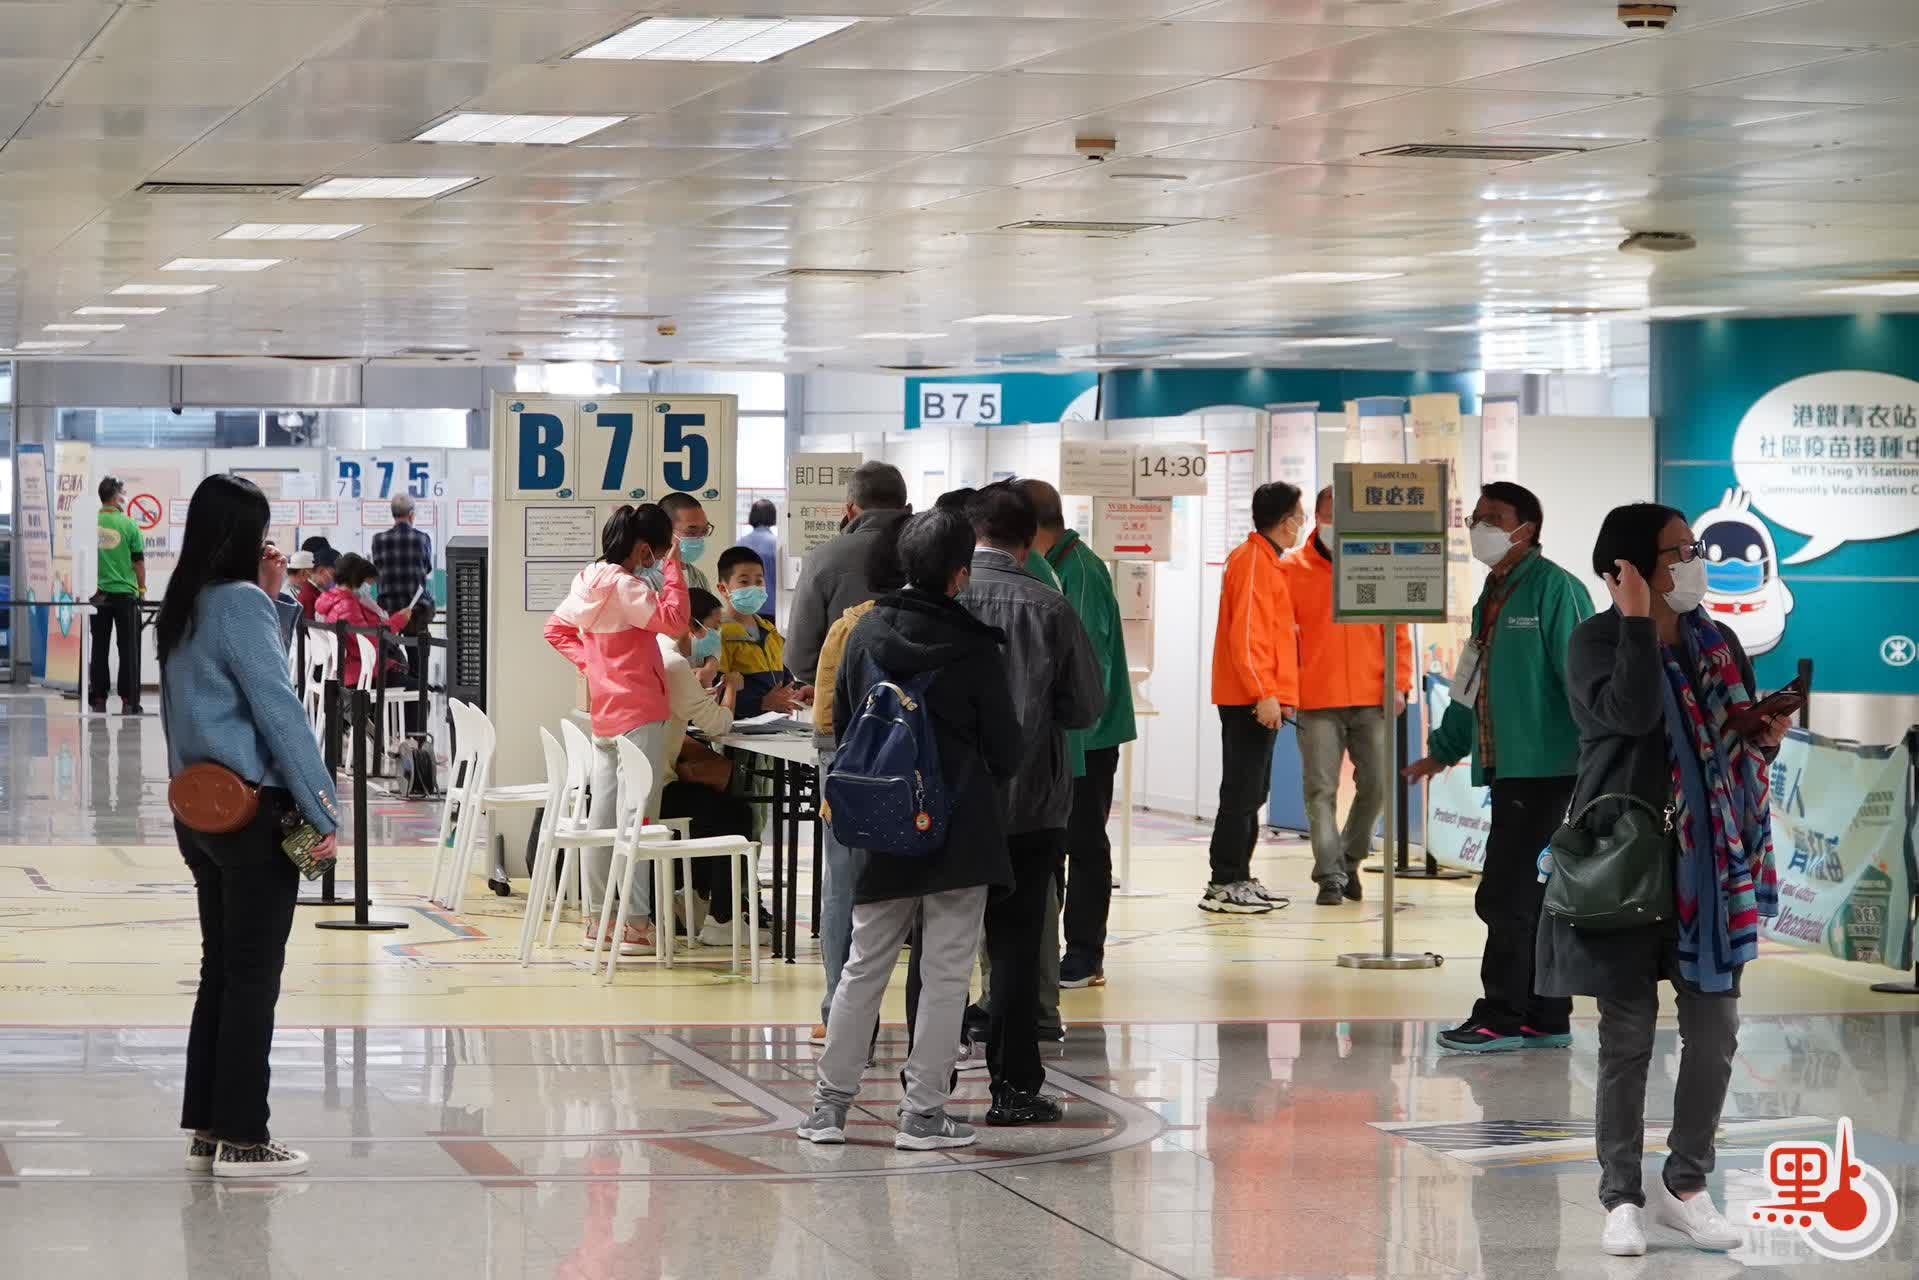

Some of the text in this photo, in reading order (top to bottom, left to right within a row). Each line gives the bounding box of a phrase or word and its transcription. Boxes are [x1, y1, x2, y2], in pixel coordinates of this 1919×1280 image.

[1793, 404, 1917, 428] 港鐵青衣站
[1140, 456, 1206, 477] 14:30
[1791, 465, 1919, 479] MTR Tsing Yi Station
[434, 481, 443, 496] 6
[1760, 485, 1829, 497] Community
[1832, 485, 1907, 496] Vaccination
